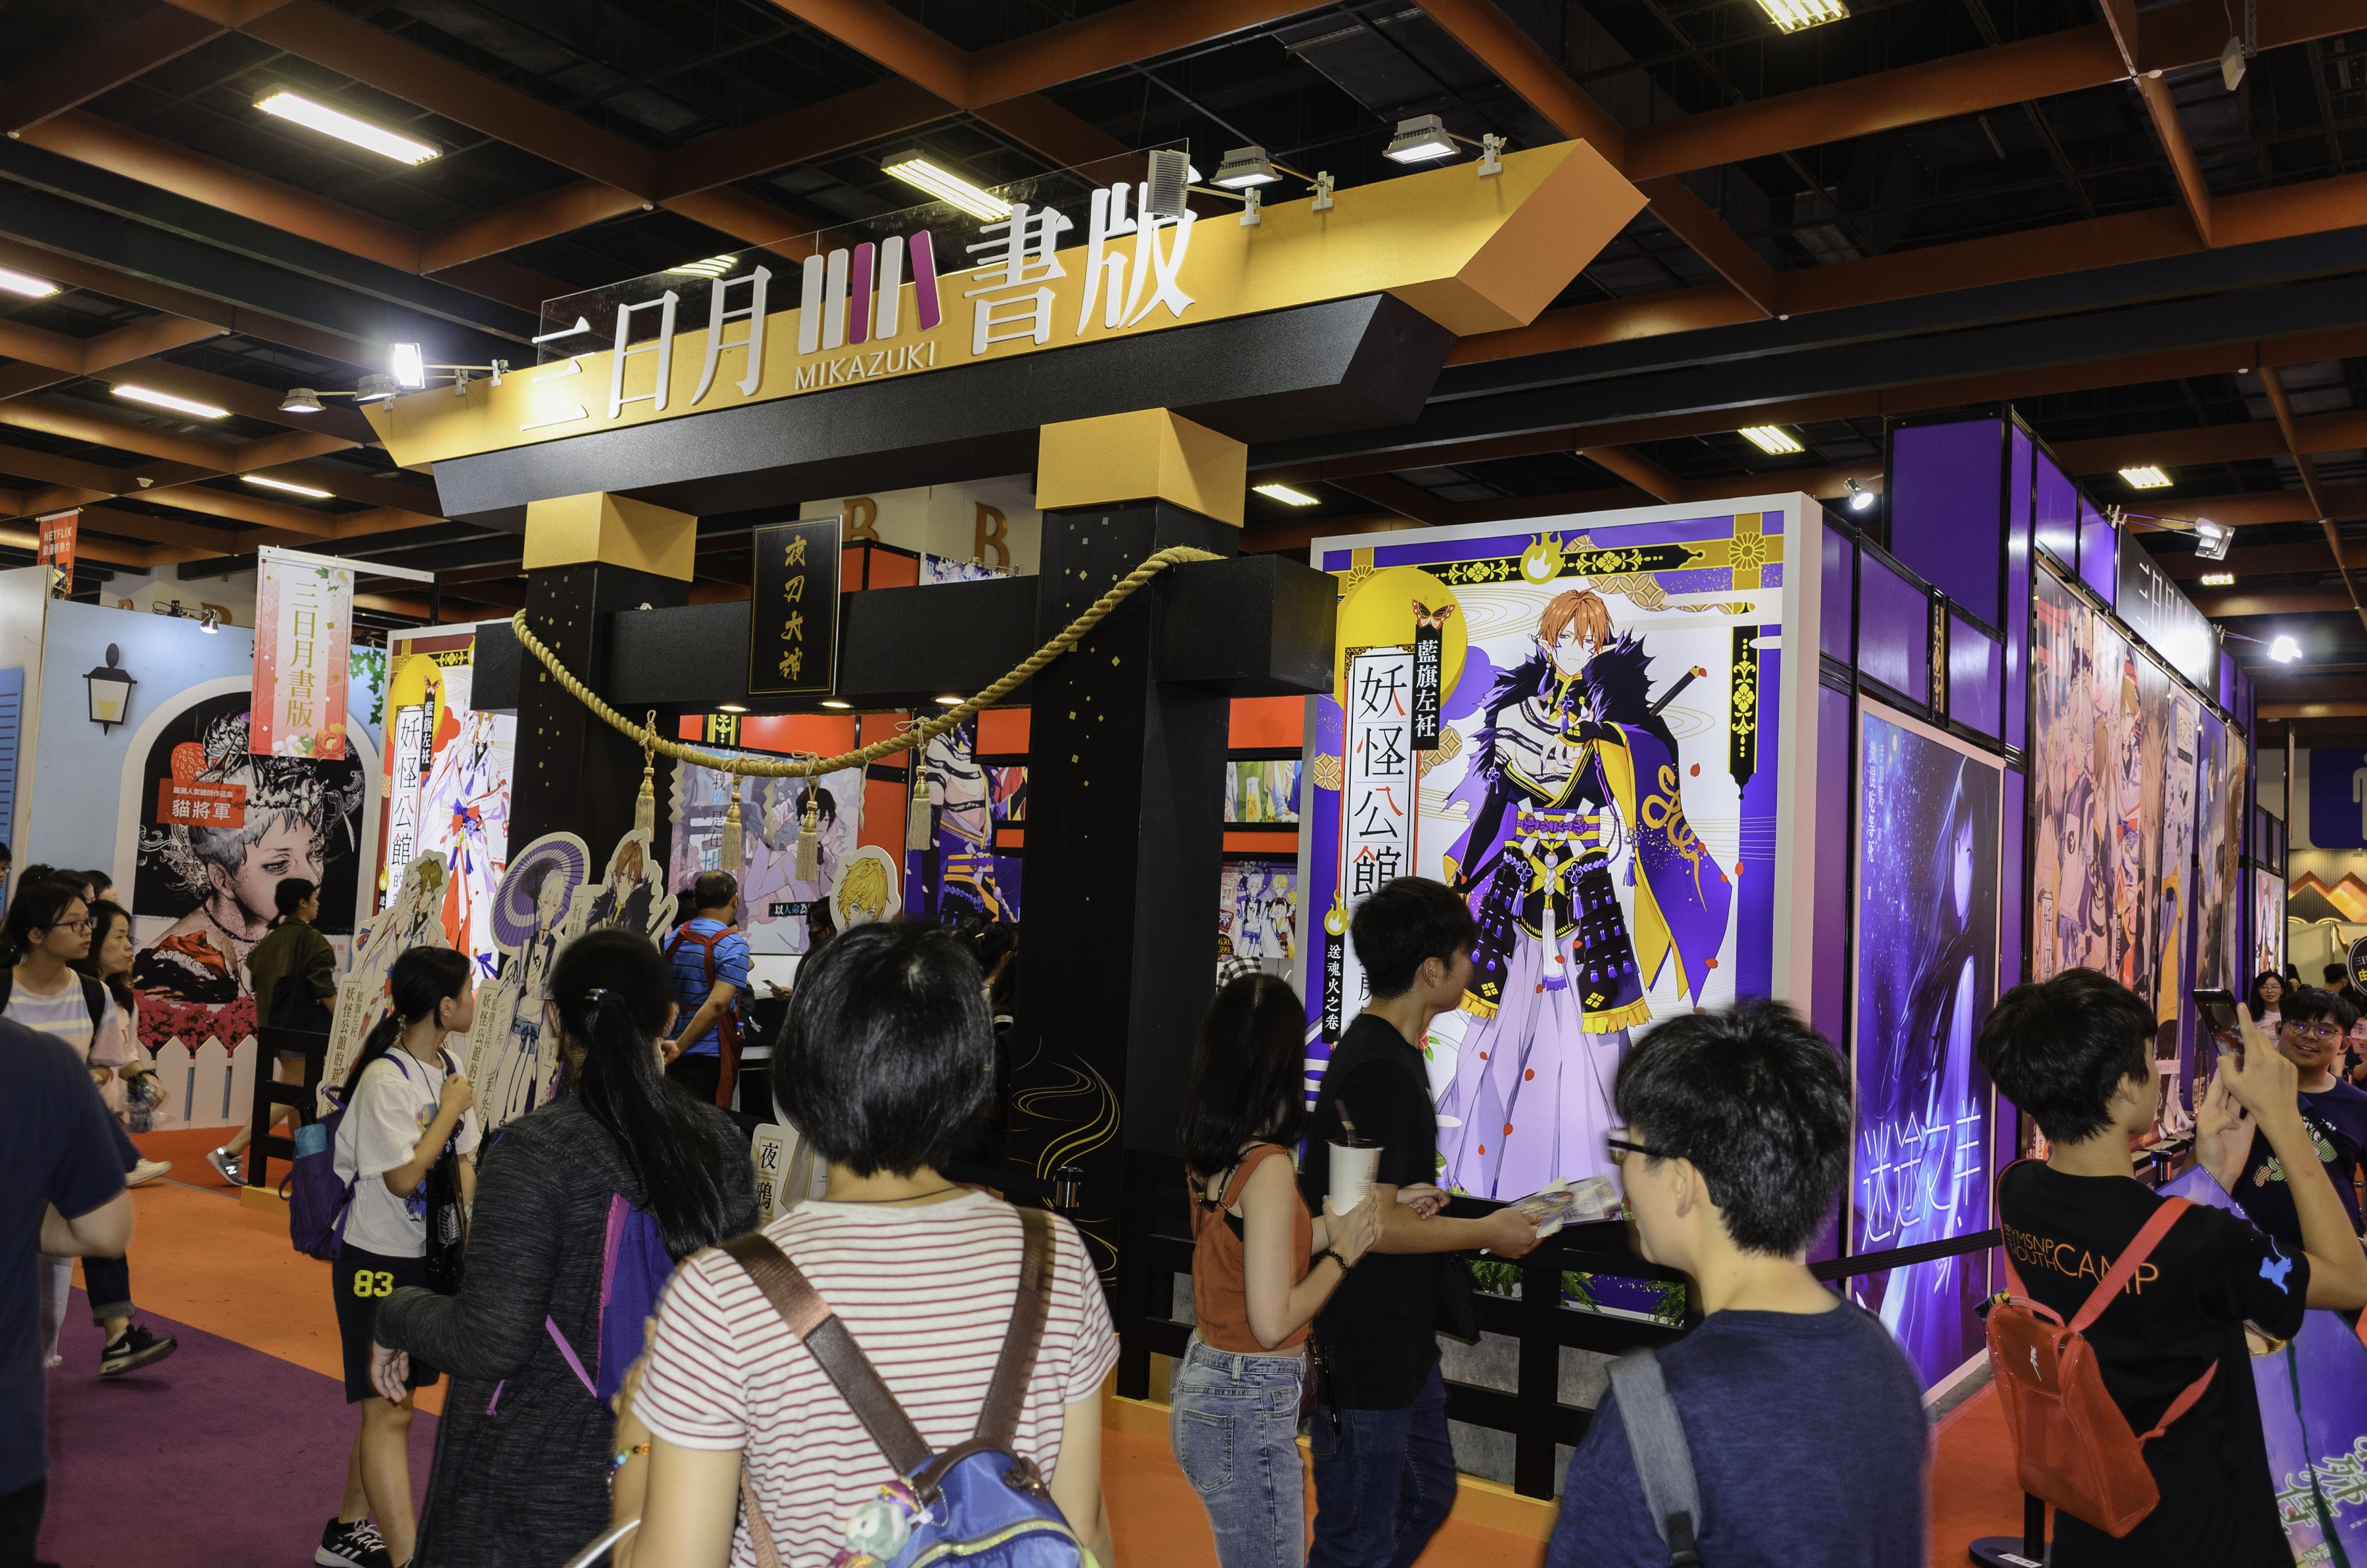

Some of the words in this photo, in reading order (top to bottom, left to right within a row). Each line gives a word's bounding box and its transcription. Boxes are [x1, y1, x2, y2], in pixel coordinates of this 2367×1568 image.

[794, 341, 936, 391] MIKAZUKI
[44, 526, 73, 542] NETFLIX
[975, 501, 1010, 575] B
[286, 582, 319, 728] 三日月書版
[1415, 640, 1439, 738] 藍旗左衽
[172, 799, 231, 820] 貓將軍
[774, 903, 810, 915] 以人命為
[1324, 944, 1341, 1030] 送魂火之卷
[1861, 1097, 1982, 1252] 迷途之羊
[353, 1269, 393, 1297] 83
